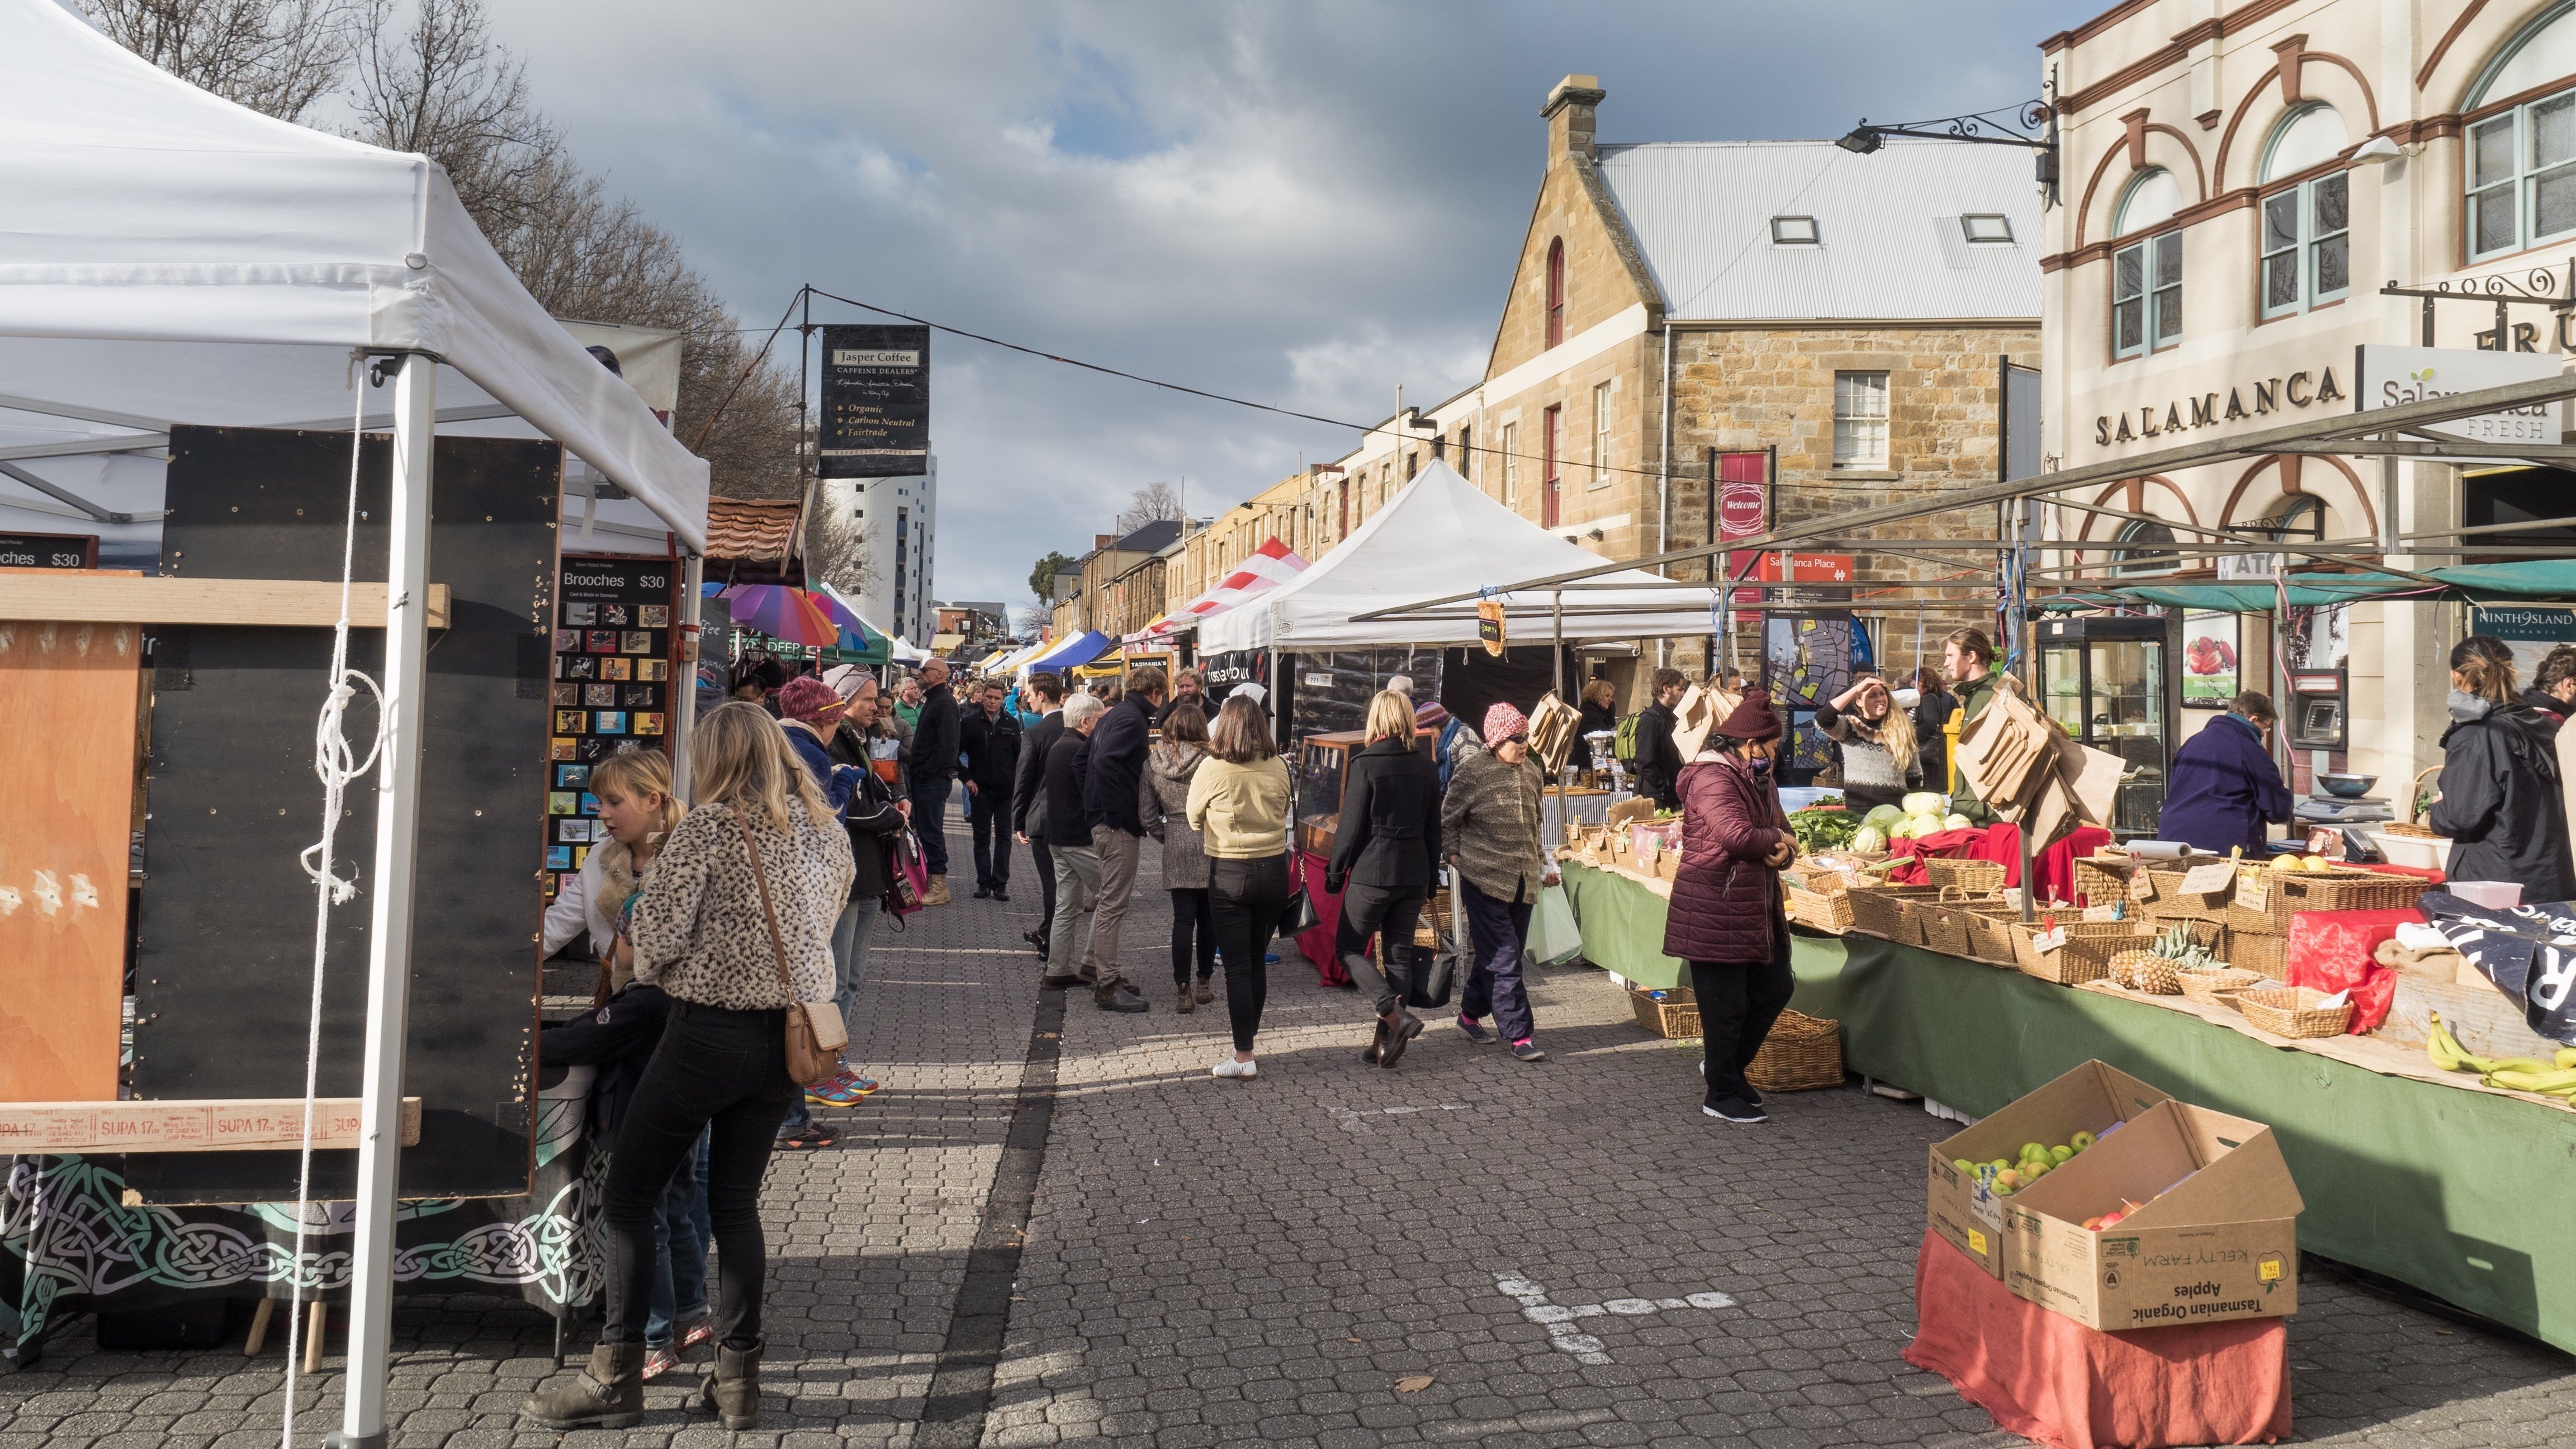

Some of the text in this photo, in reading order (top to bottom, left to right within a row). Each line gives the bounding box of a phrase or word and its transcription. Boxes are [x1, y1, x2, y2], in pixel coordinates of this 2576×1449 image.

[841, 352, 911, 363] Jasper Coffee
[849, 404, 884, 414] Organic
[2096, 366, 2346, 446] SALAMANCA
[849, 416, 915, 427] Carbon Neutral
[2467, 419, 2544, 438] FRESH
[848, 428, 888, 437] Fairtrade
[1727, 501, 1760, 509] Welcome
[0, 551, 79, 567] ches $30
[1770, 557, 1835, 568] Salanca Place
[564, 572, 665, 588] Brooches $30
[699, 659, 726, 671] ganic
[102, 1121, 136, 1135] SUPA
[218, 1119, 253, 1133] SUPA
[2143, 1247, 2248, 1267] KELTY FARM
[2034, 1278, 2053, 1291] Organic
[2174, 1281, 2221, 1298] Apples
[2053, 1285, 2080, 1303] Tasmanian
[2132, 1299, 2262, 1320] Tasmanian Organic
